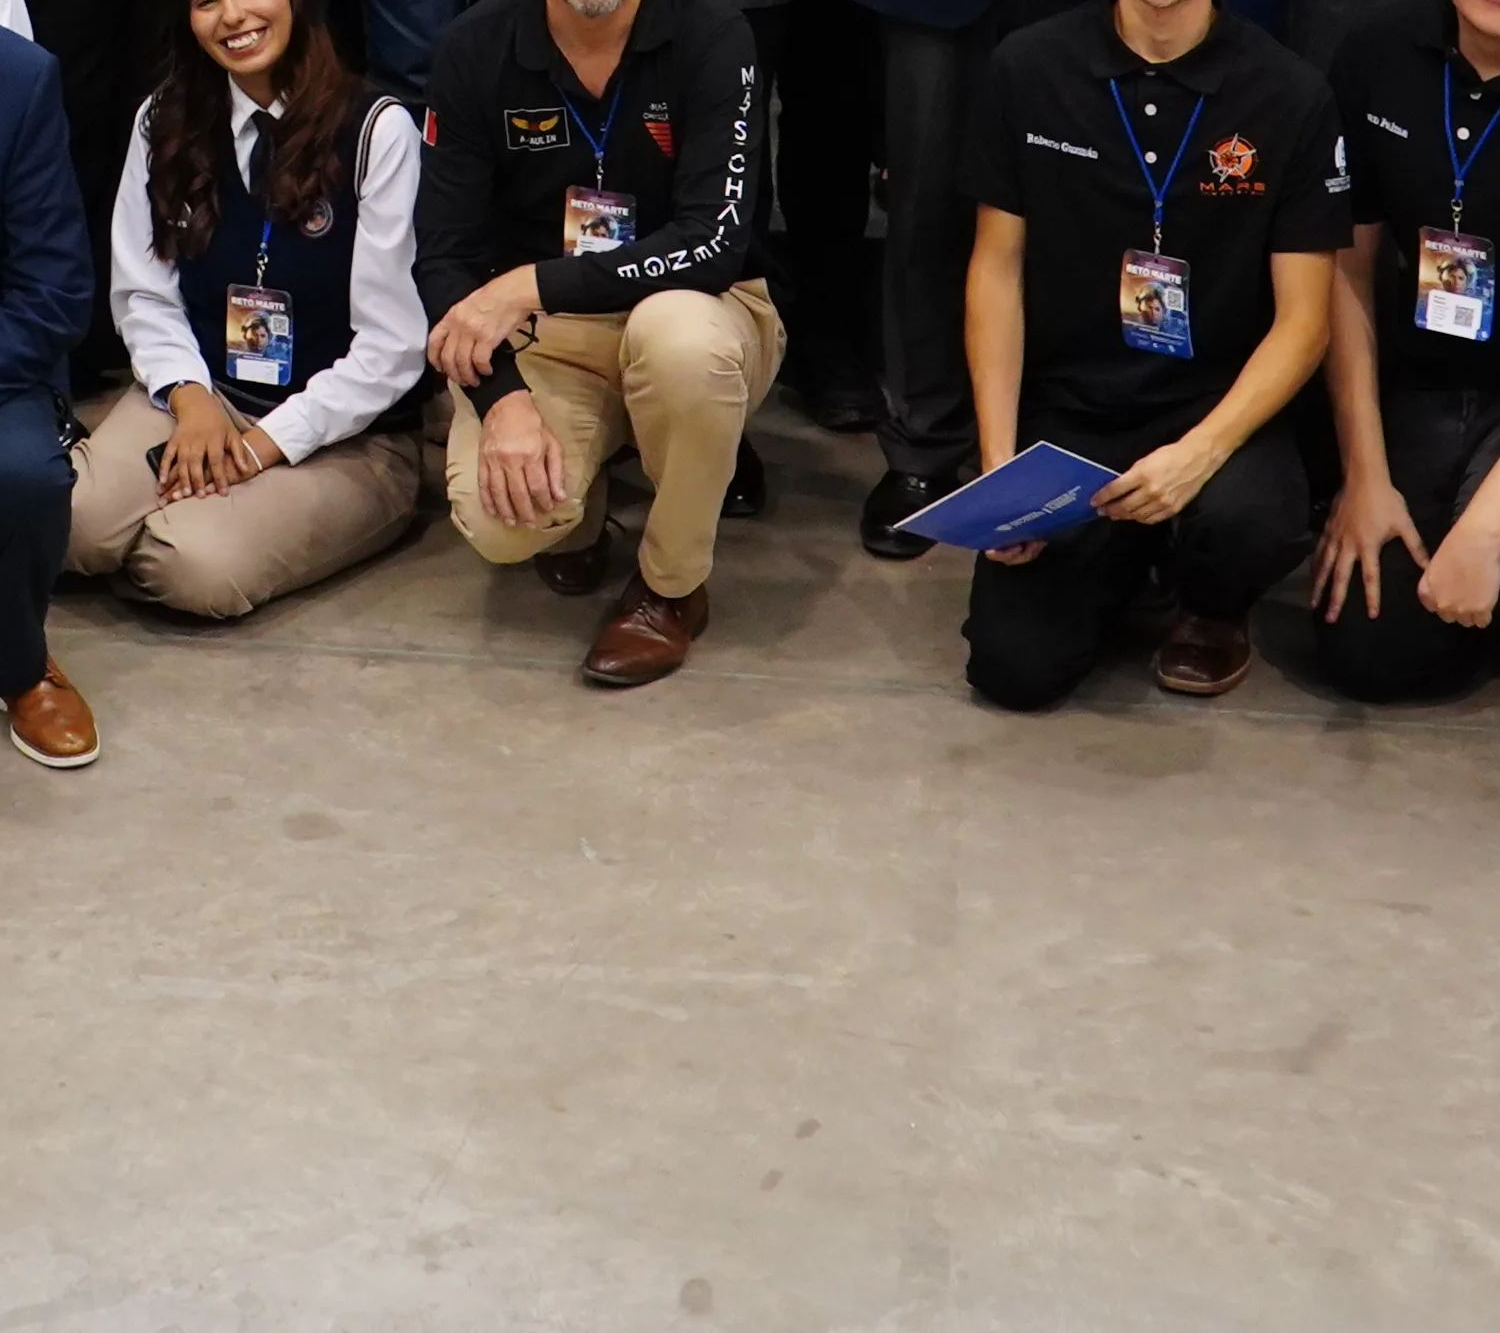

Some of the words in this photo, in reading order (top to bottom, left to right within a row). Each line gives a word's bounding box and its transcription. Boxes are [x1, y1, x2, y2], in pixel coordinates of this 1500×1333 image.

[1027, 132, 1060, 150] Roberto
[571, 198, 594, 212] RETO
[596, 202, 629, 217] MARTE
[1424, 240, 1450, 254] RETO
[1451, 244, 1487, 260] MARTE
[1127, 263, 1149, 278] RETO
[1150, 268, 1182, 285] MARTE
[231, 297, 253, 307] RETO
[254, 299, 285, 311] MARTE
